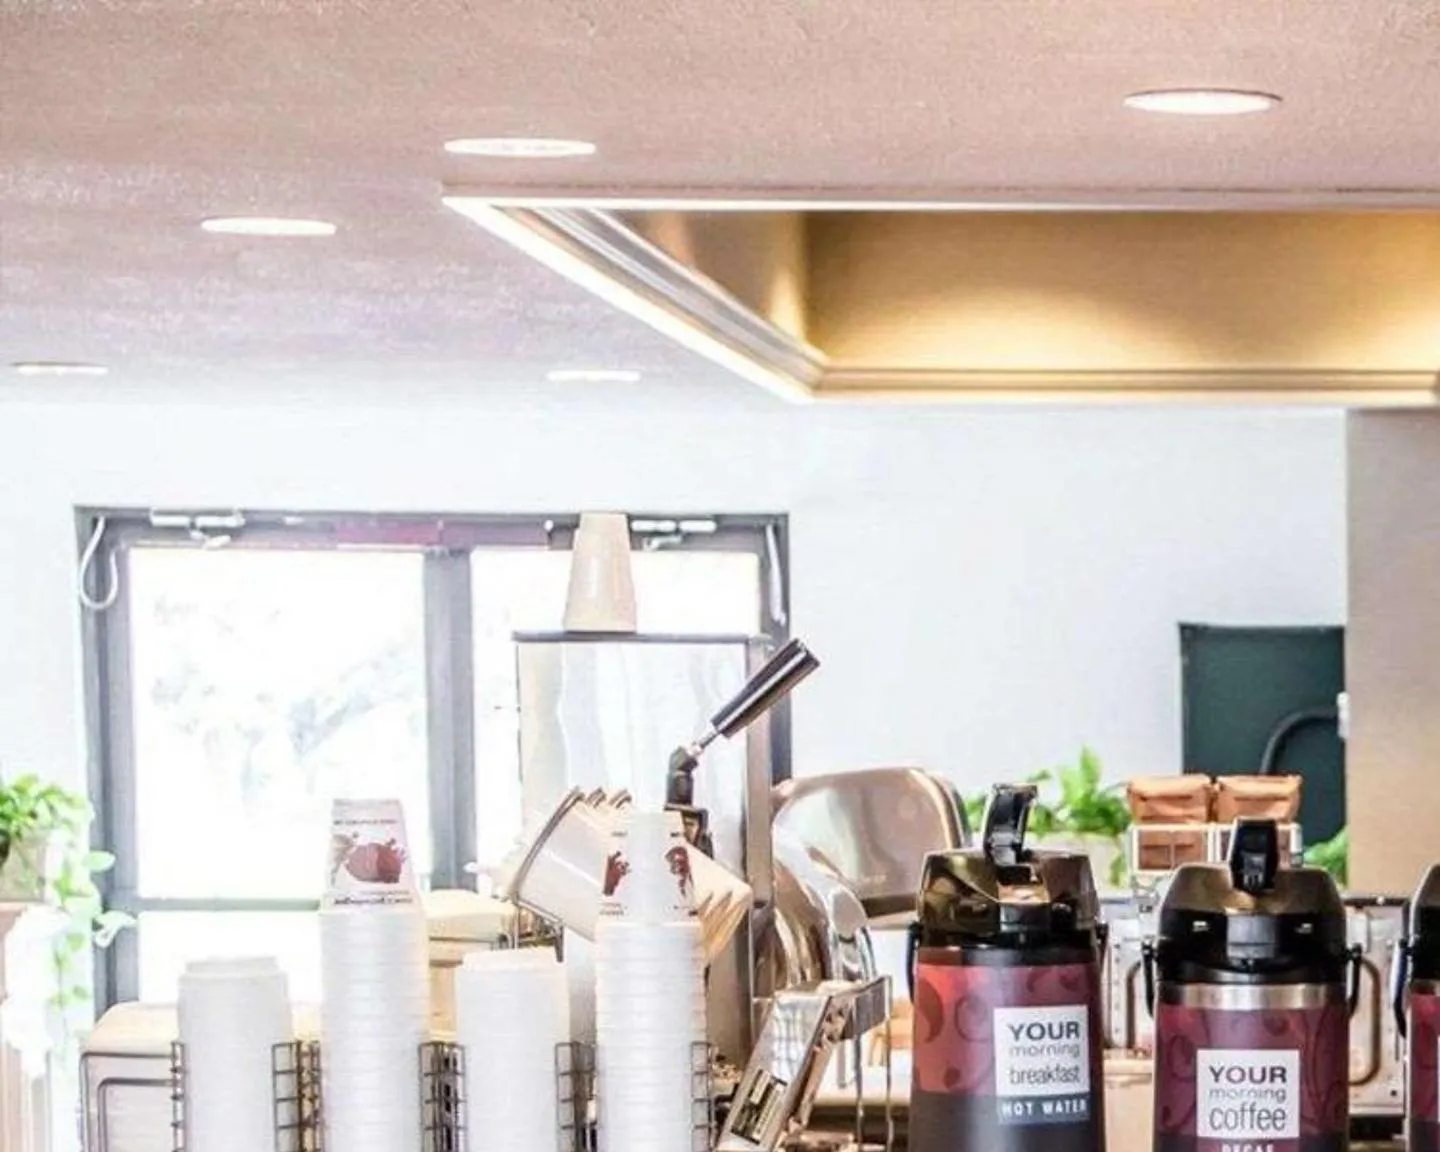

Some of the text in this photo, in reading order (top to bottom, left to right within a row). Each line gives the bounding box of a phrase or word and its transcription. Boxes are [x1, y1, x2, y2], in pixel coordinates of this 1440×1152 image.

[1008, 1021, 1080, 1041] YOUR
[1010, 1044, 1080, 1058] morning
[1010, 1064, 1080, 1085] breakfast
[1209, 1065, 1287, 1084] YOUR
[1209, 1088, 1286, 1104] morning
[1001, 1099, 1087, 1116] HOT WATER
[1209, 1101, 1286, 1131] coffee
